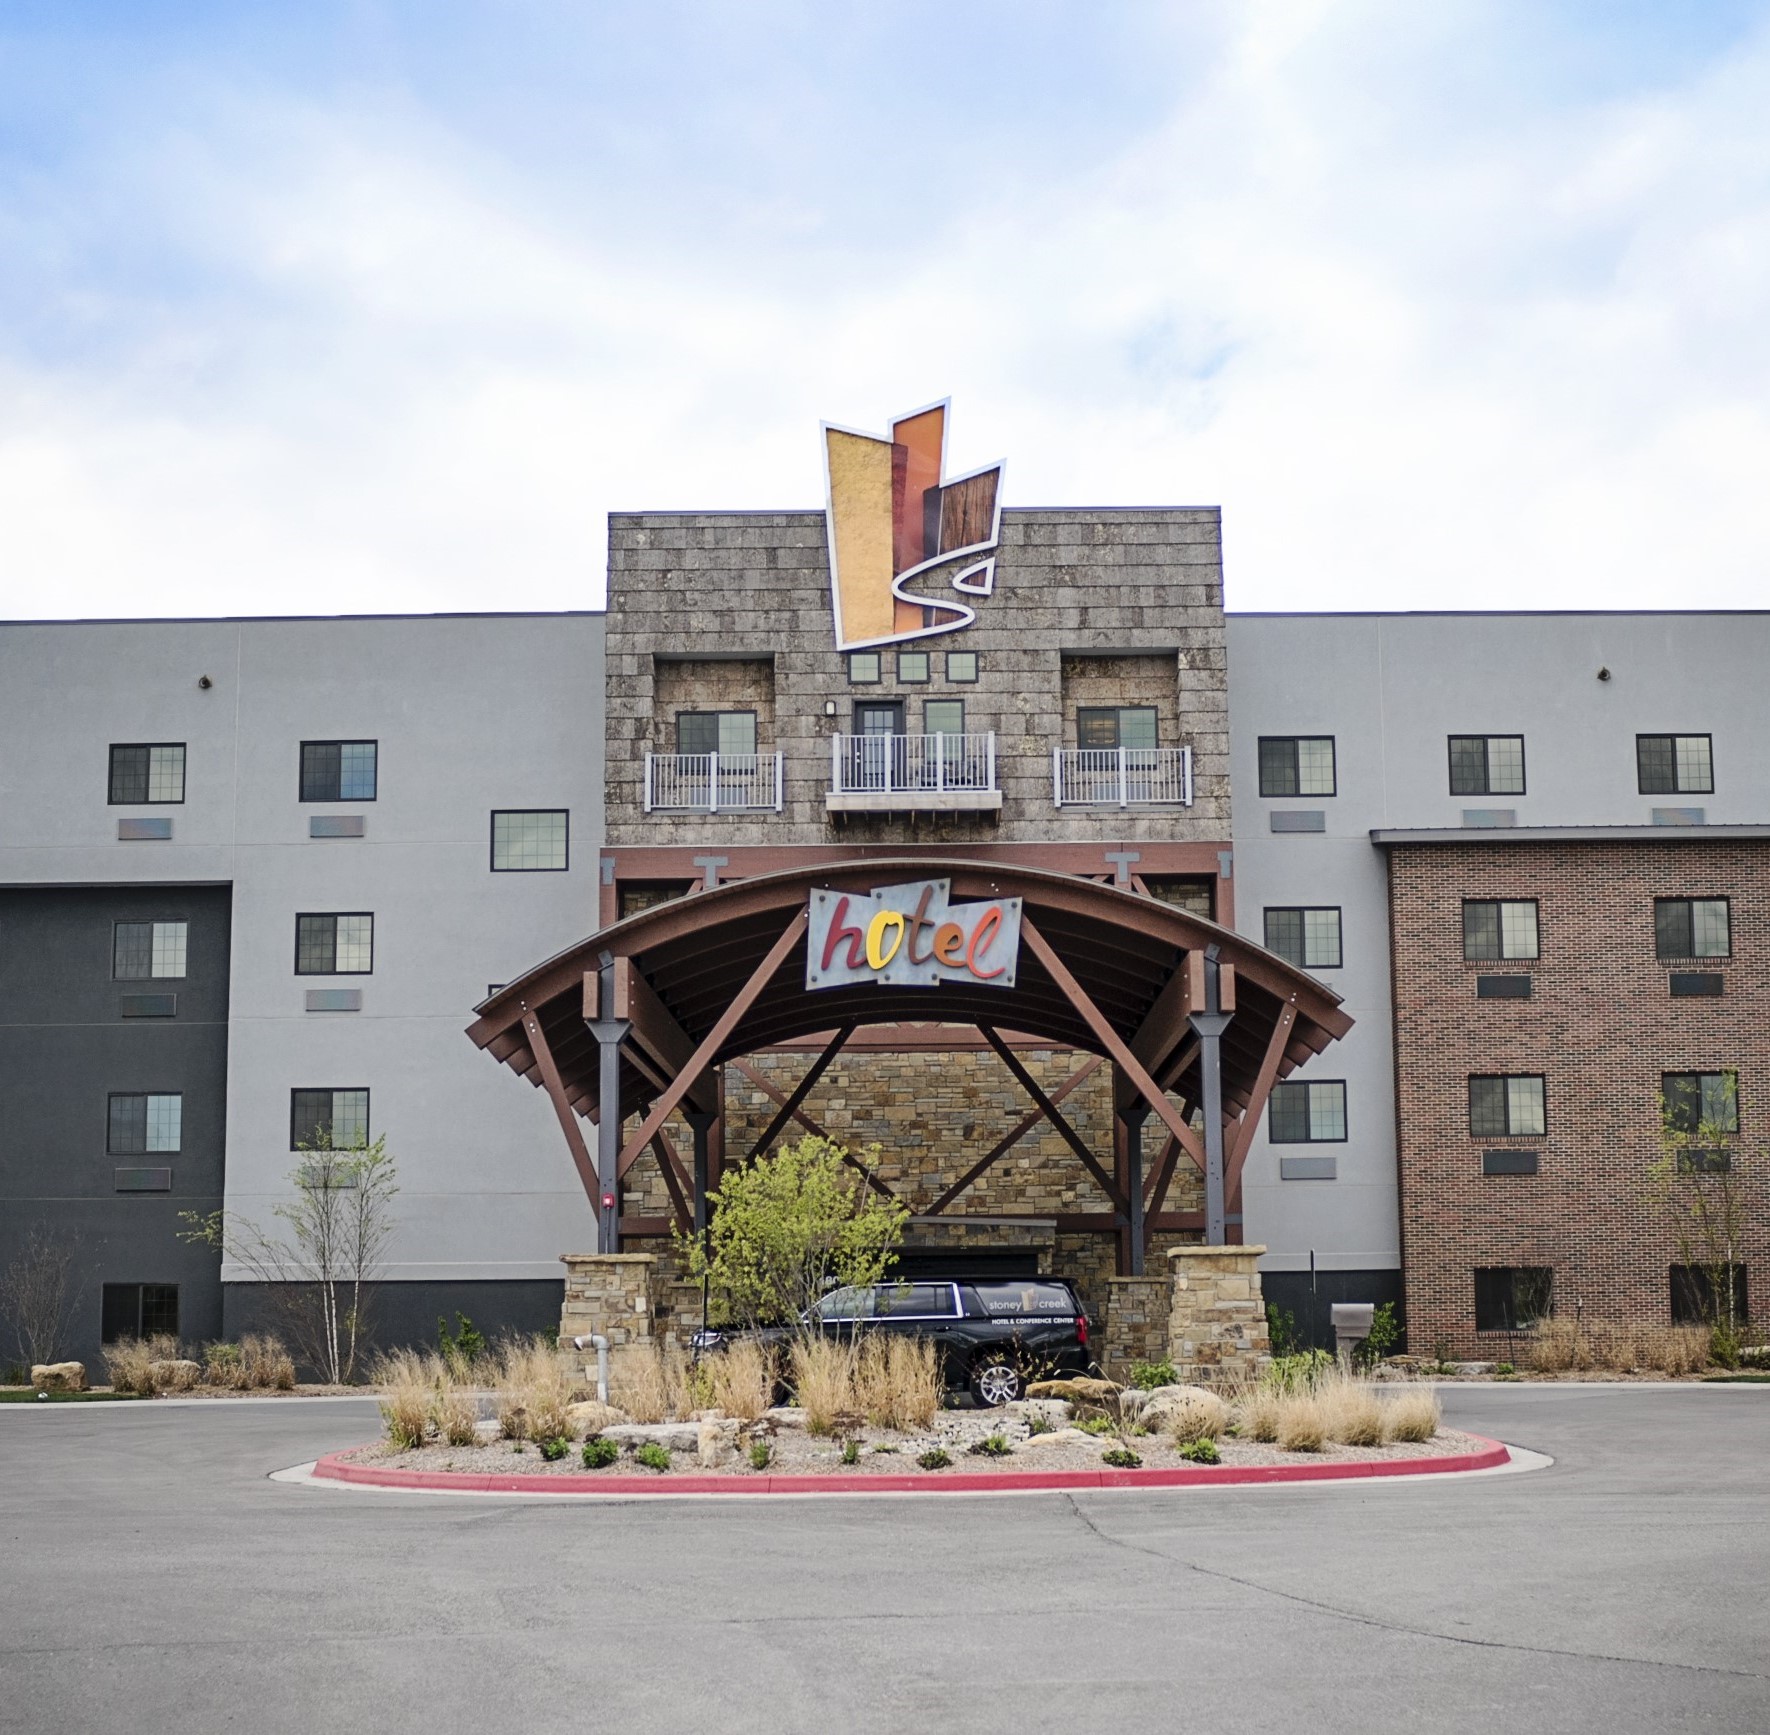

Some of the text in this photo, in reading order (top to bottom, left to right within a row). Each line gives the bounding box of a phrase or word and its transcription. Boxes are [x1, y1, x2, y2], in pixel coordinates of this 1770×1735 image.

[821, 884, 1006, 979] hotel
[989, 1297, 1067, 1311] stoney creek
